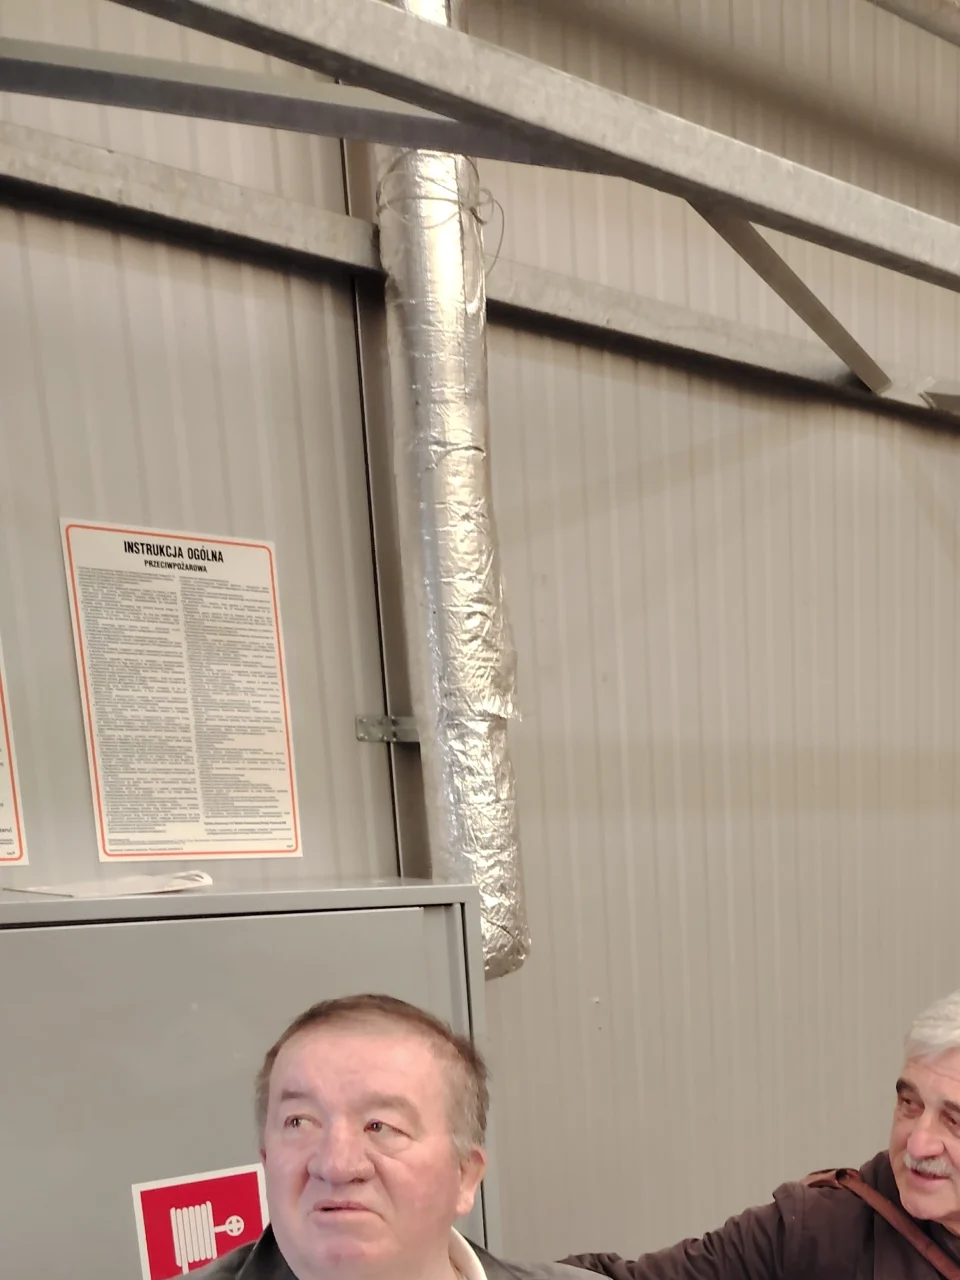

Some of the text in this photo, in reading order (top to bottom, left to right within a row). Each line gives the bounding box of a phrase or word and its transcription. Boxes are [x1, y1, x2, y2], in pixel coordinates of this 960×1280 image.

[123, 540, 224, 563] INSTRUKCJA OGÓLNA
[144, 559, 208, 573] PRZECIWPOŻAROWA
